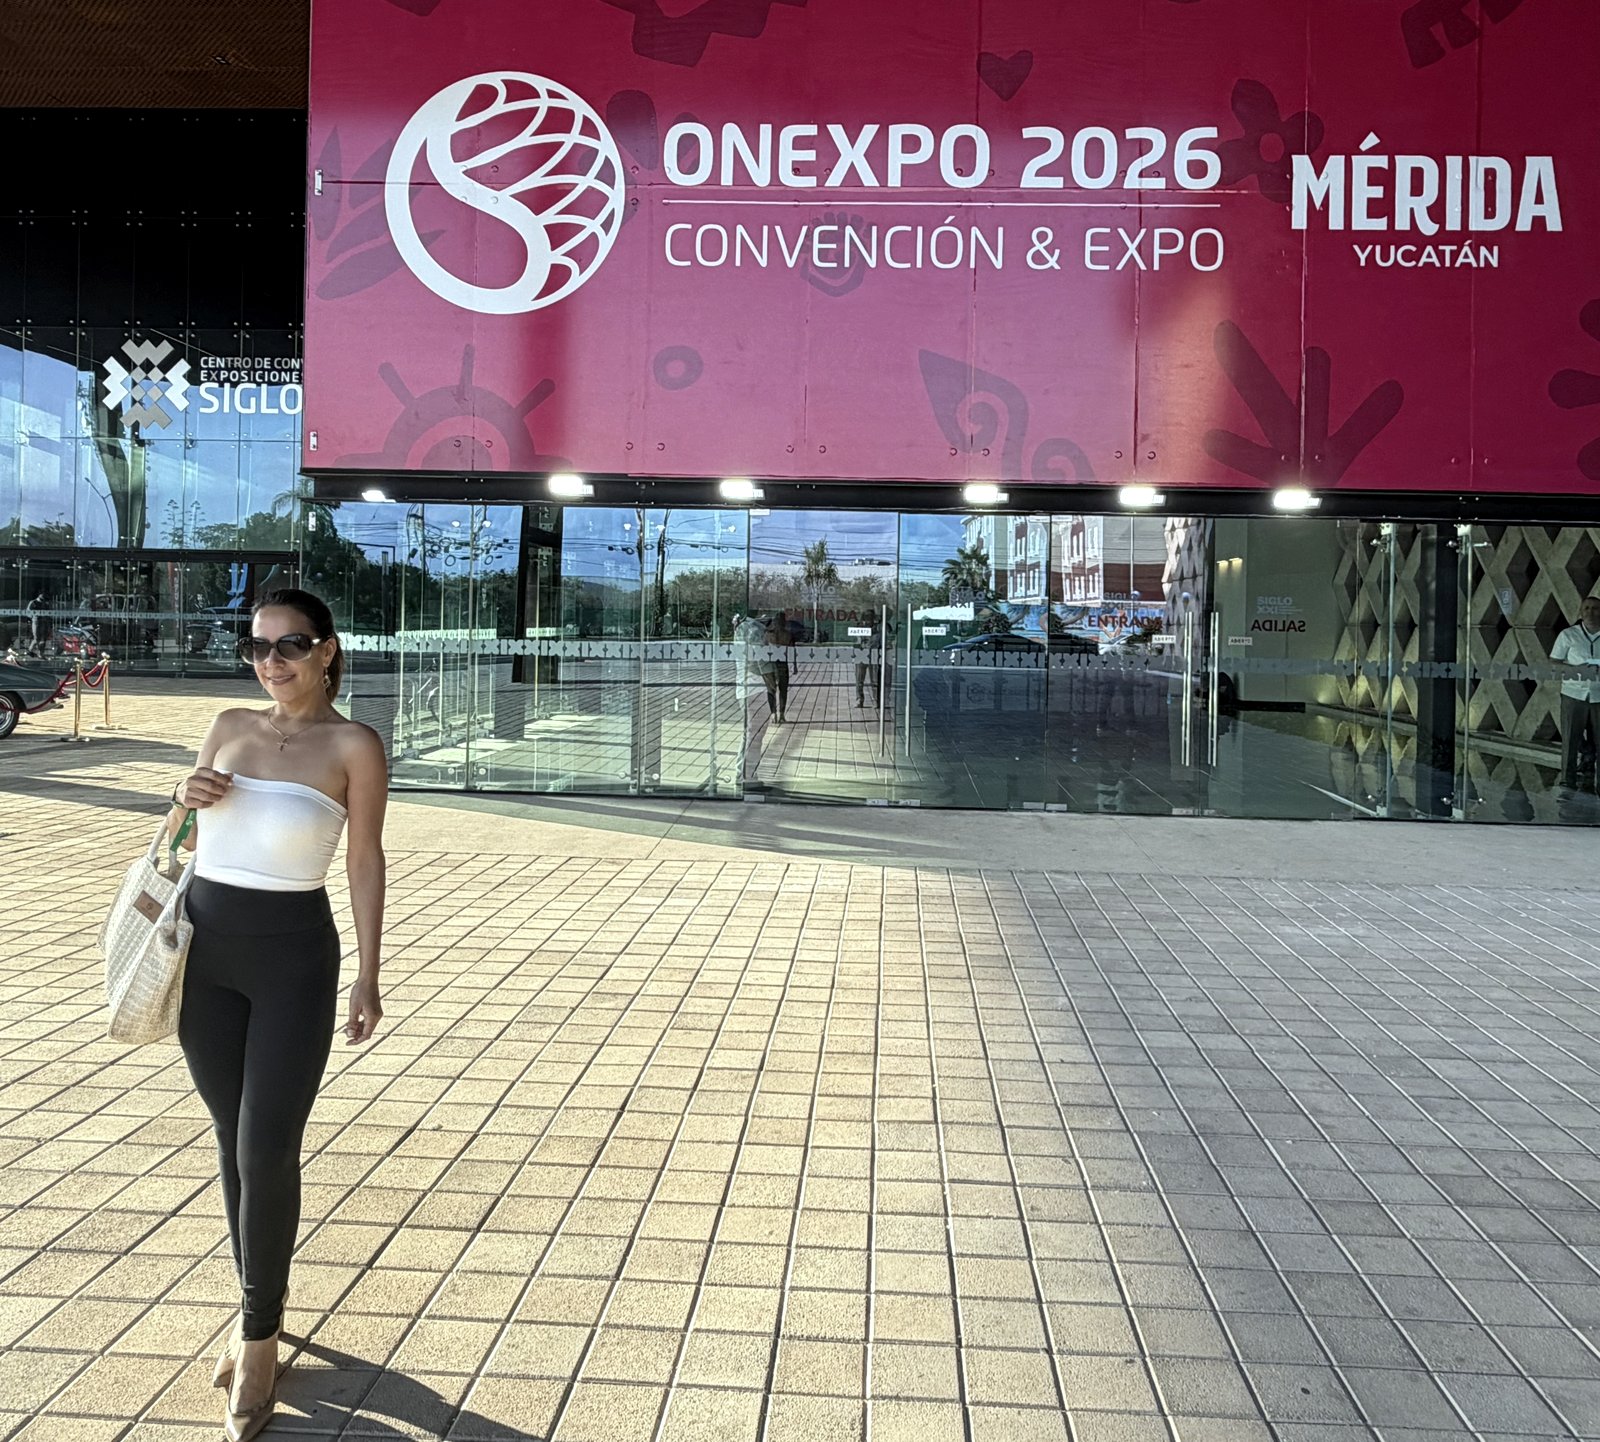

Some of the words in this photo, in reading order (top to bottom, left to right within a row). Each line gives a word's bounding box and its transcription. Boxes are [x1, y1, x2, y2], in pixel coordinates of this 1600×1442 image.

[663, 122, 990, 188] ONEXPO
[1020, 126, 1221, 190] 2026
[1291, 132, 1563, 236] MÉRIDA
[664, 216, 1003, 269] CONVENCIÓN
[1025, 226, 1061, 270] &
[1084, 227, 1224, 271] EXPO
[1353, 240, 1499, 267] YUCATÁN
[200, 356, 252, 369] CENTRO
[254, 357, 271, 369] DE
[273, 357, 304, 370] CON
[200, 370, 304, 383] EXPOSICIONE
[199, 381, 304, 416] SIGLO
[1256, 595, 1293, 606] SIGLO
[1256, 606, 1278, 615] XXI
[784, 606, 859, 621] ENTRADA
